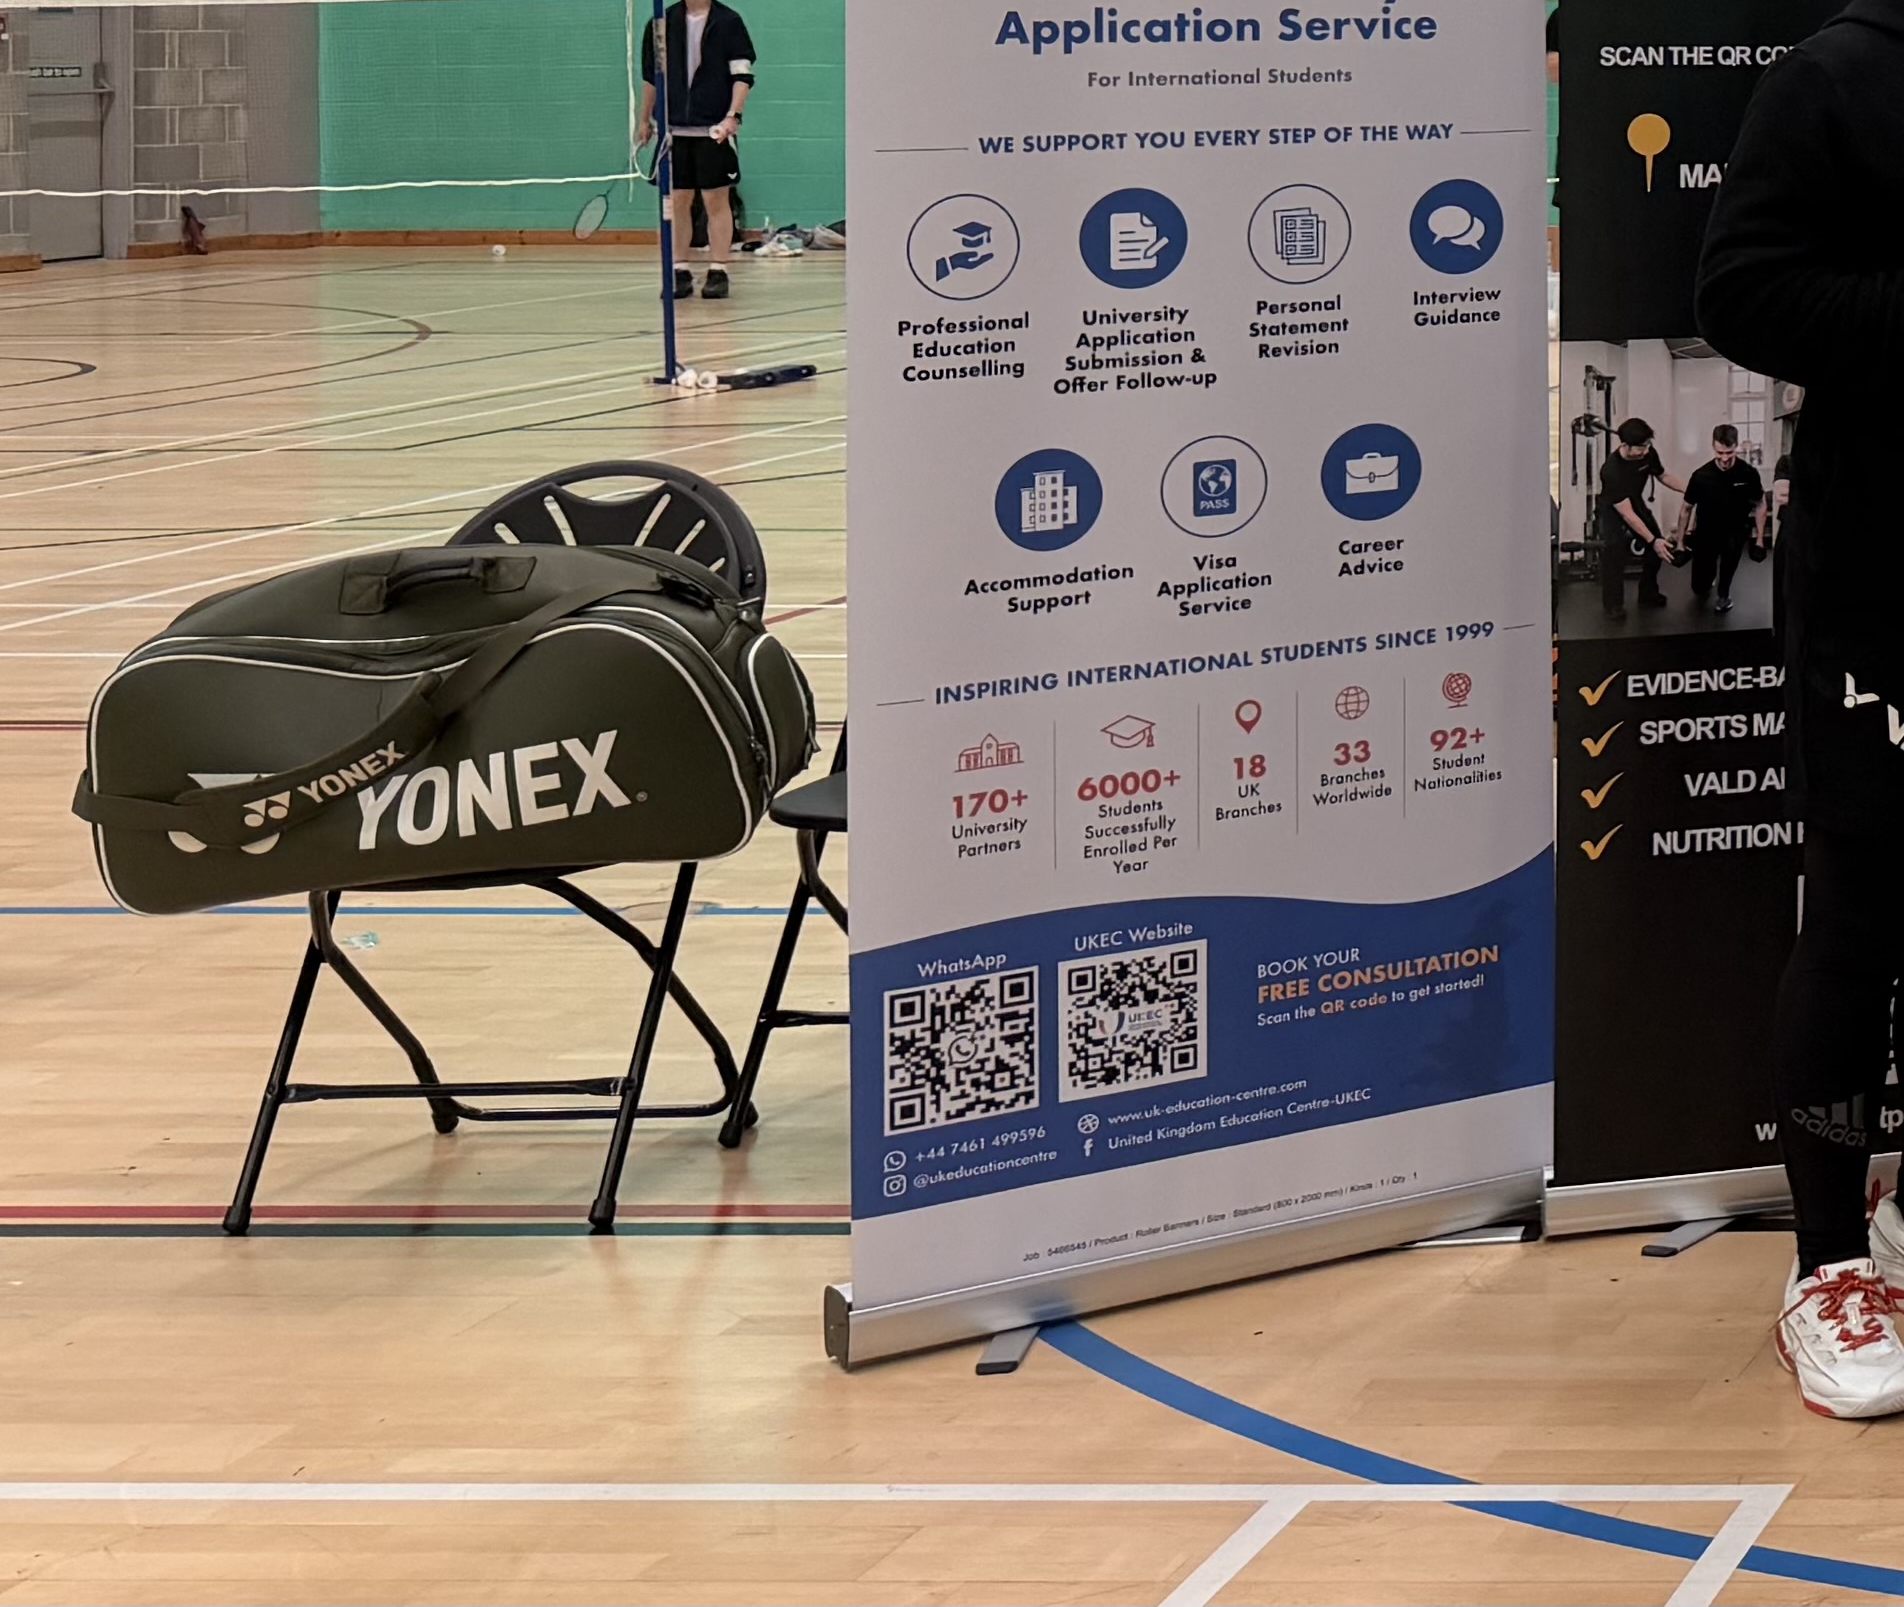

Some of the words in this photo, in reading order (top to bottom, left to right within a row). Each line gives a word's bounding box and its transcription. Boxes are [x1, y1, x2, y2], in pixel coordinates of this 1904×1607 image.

[995, 7, 1260, 54] Application
[1279, 6, 1436, 41] Service
[1600, 47, 1664, 66] SCAN
[1668, 46, 1713, 65] THE
[1718, 46, 1751, 66] QR
[1088, 72, 1120, 87] For
[1129, 68, 1260, 86] International
[1268, 67, 1352, 83] Students
[979, 137, 1013, 154] WE
[1023, 133, 1127, 152] SUPPORT
[1135, 132, 1184, 148] YOU
[1195, 130, 1260, 146] EVERY
[1269, 128, 1316, 144] STEP
[1324, 127, 1352, 142] OF
[1360, 126, 1398, 141] THE
[1406, 124, 1453, 140] WAY
[1257, 294, 1340, 315] Personal
[1414, 287, 1501, 305] Interview
[898, 311, 1028, 336] Professional
[1083, 306, 1189, 325] University
[1414, 309, 1500, 326] Guidance
[1250, 319, 1348, 337] Statement
[914, 338, 1015, 358] Education
[1076, 328, 1194, 352] Application
[1259, 340, 1338, 358] Revision
[903, 360, 1024, 381] Counselling
[1066, 350, 1182, 371] Submission
[1191, 348, 1205, 363] &
[1054, 376, 1108, 394] Offer
[1117, 372, 1217, 390] Follow-up
[1339, 540, 1404, 555] Career
[1193, 554, 1236, 570] Visa
[1338, 558, 1403, 577] Advice
[965, 565, 1133, 595] Accommodation
[1157, 572, 1271, 600] Application
[1008, 591, 1091, 614] Support
[1179, 596, 1251, 616] Service
[936, 673, 1058, 704] INSPIRING
[1068, 651, 1253, 687] INTERNATIONAL
[1261, 637, 1367, 664] STUDENTS
[1376, 629, 1436, 650] SINCE
[1446, 622, 1494, 641] 1999
[1430, 727, 1485, 752] 92+
[1640, 715, 1747, 744] SPORTS
[1334, 740, 1371, 765] 33
[1433, 754, 1484, 770] Student
[298, 741, 408, 810] YONEX
[1234, 755, 1266, 779] 18
[1321, 767, 1385, 787] Branches
[357, 730, 631, 850] YONEX
[1078, 769, 1181, 801] 6000+
[1239, 783, 1259, 798] UK
[1415, 770, 1501, 791] Nationalities
[1684, 770, 1756, 796] VALD
[953, 789, 1028, 818] 170+
[1313, 783, 1392, 805] Worldwide
[1099, 800, 1163, 818] Students
[1216, 801, 1282, 821] Branches
[952, 818, 1027, 839] University
[1085, 815, 1176, 839] Successfully
[1653, 822, 1791, 855] NUTRITION
[959, 840, 1021, 858] Partners
[1084, 837, 1155, 858] Enrolled
[1162, 838, 1177, 848] Per
[1113, 860, 1148, 873] Year
[1075, 931, 1122, 951] UKEC
[1128, 923, 1192, 942] Website
[918, 954, 1006, 977] WhatsApp
[1258, 957, 1307, 978] BOOK
[1314, 948, 1359, 967] YOUR
[1259, 979, 1309, 1003] FREE
[1317, 945, 1500, 997] CONSULTATION
[1258, 1013, 1290, 1026] Scan
[1295, 1005, 1315, 1019] the
[1321, 1000, 1344, 1013] QR
[1350, 993, 1387, 1009] code
[1392, 991, 1404, 1001] to
[1409, 985, 1430, 1002] get
[1435, 974, 1483, 994] started!
[1108, 1077, 1307, 1126] www.uk-education-centre.com
[1109, 1130, 1152, 1149] United
[1157, 1122, 1215, 1146] Kingdom
[1220, 1109, 1283, 1127] Education
[1287, 1088, 1371, 1121] Centre-UKEC
[1790, 1107, 1867, 1147] adidas
[916, 1146, 945, 1161] +44
[951, 1138, 984, 1154] 7461
[992, 1126, 1045, 1146] 499596
[913, 1146, 1057, 1188] @ukeducationcentre
